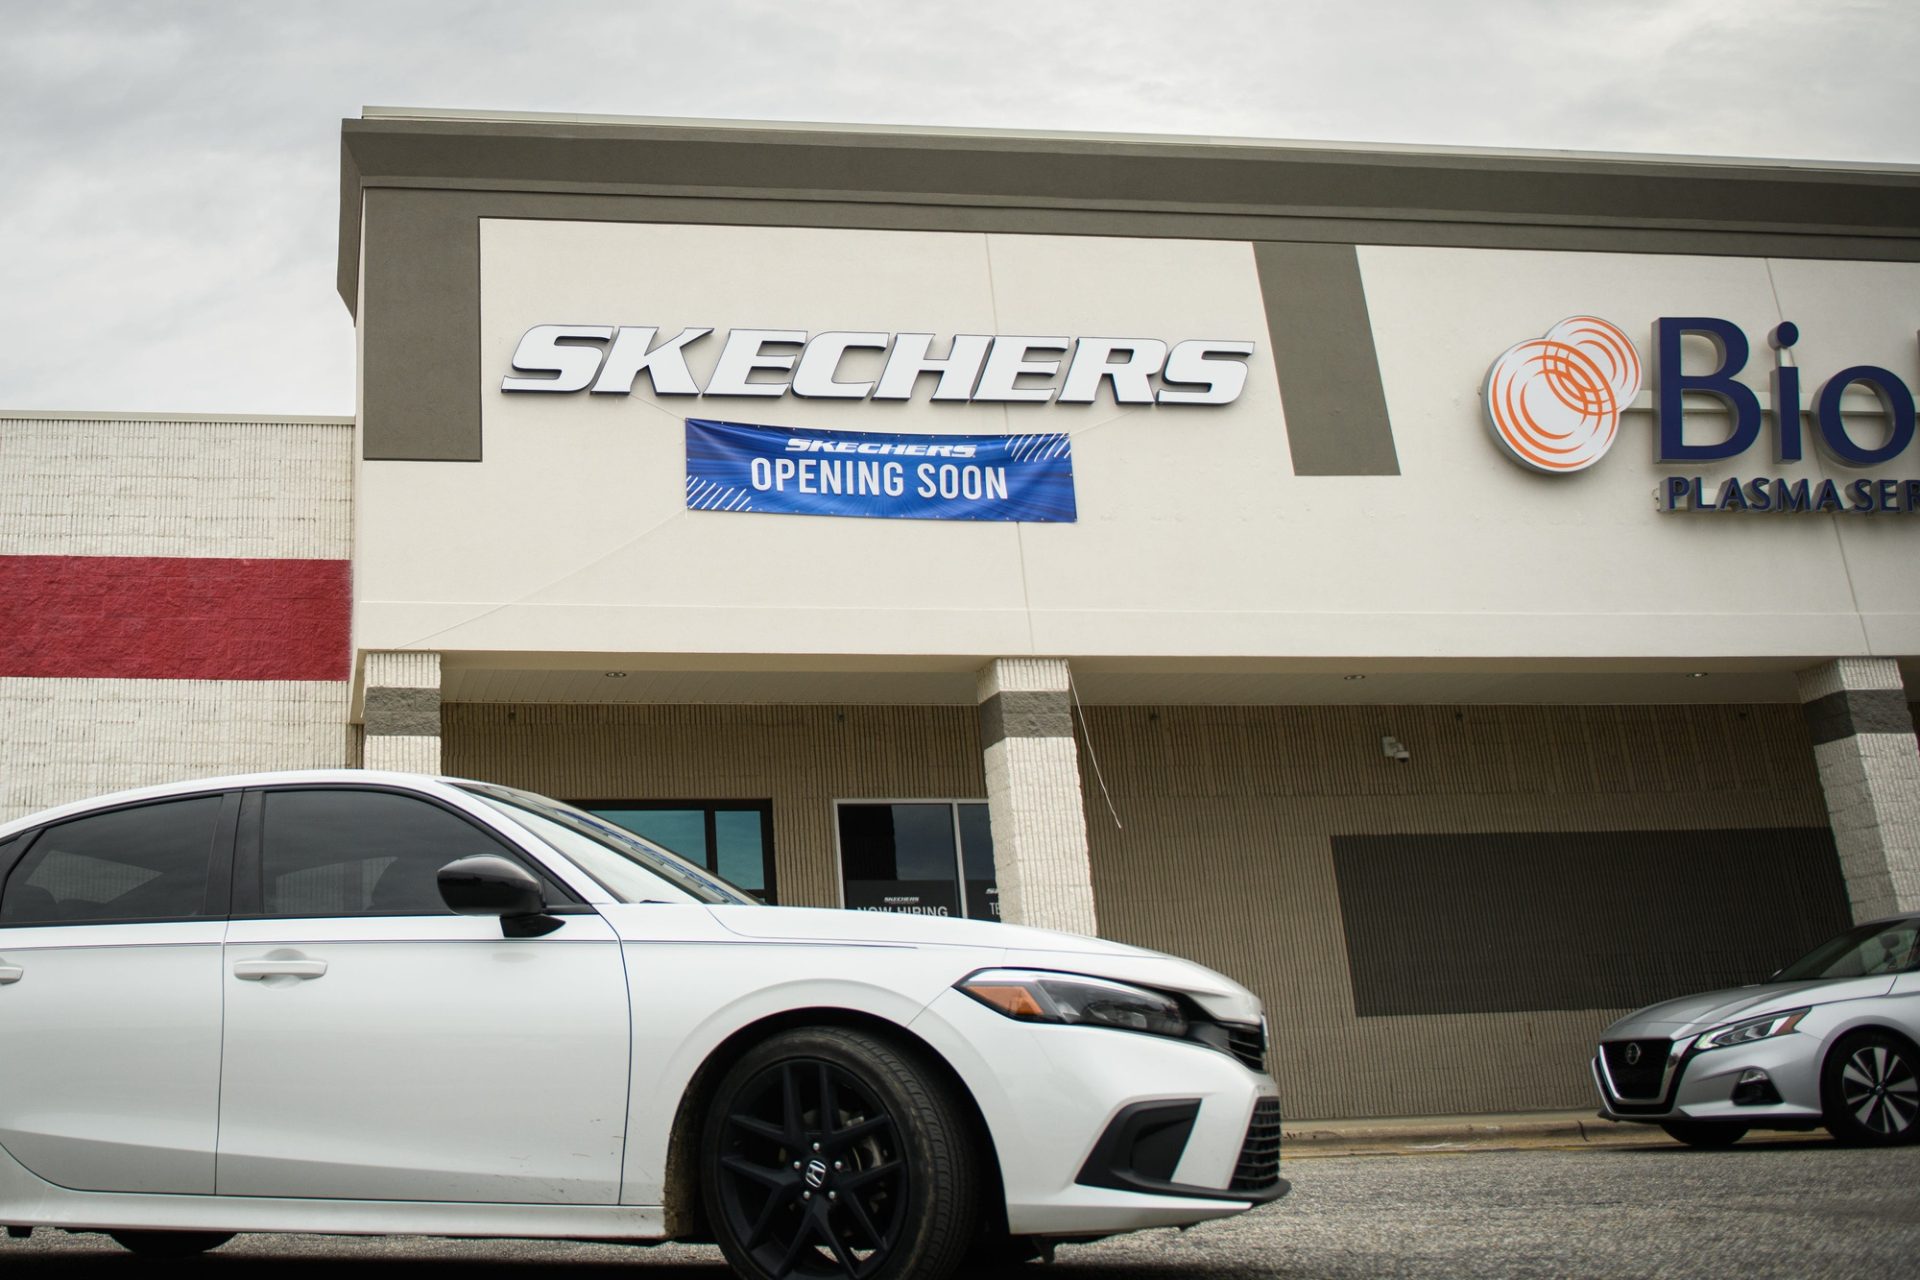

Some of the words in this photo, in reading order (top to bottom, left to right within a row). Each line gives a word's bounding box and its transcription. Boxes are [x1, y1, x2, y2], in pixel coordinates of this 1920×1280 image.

[501, 324, 1256, 406] SKECHERS
[785, 438, 977, 458] SKECHERS
[751, 457, 904, 497] OPENING
[917, 462, 1009, 500] SOON
[1664, 476, 1844, 513] PLASMA
